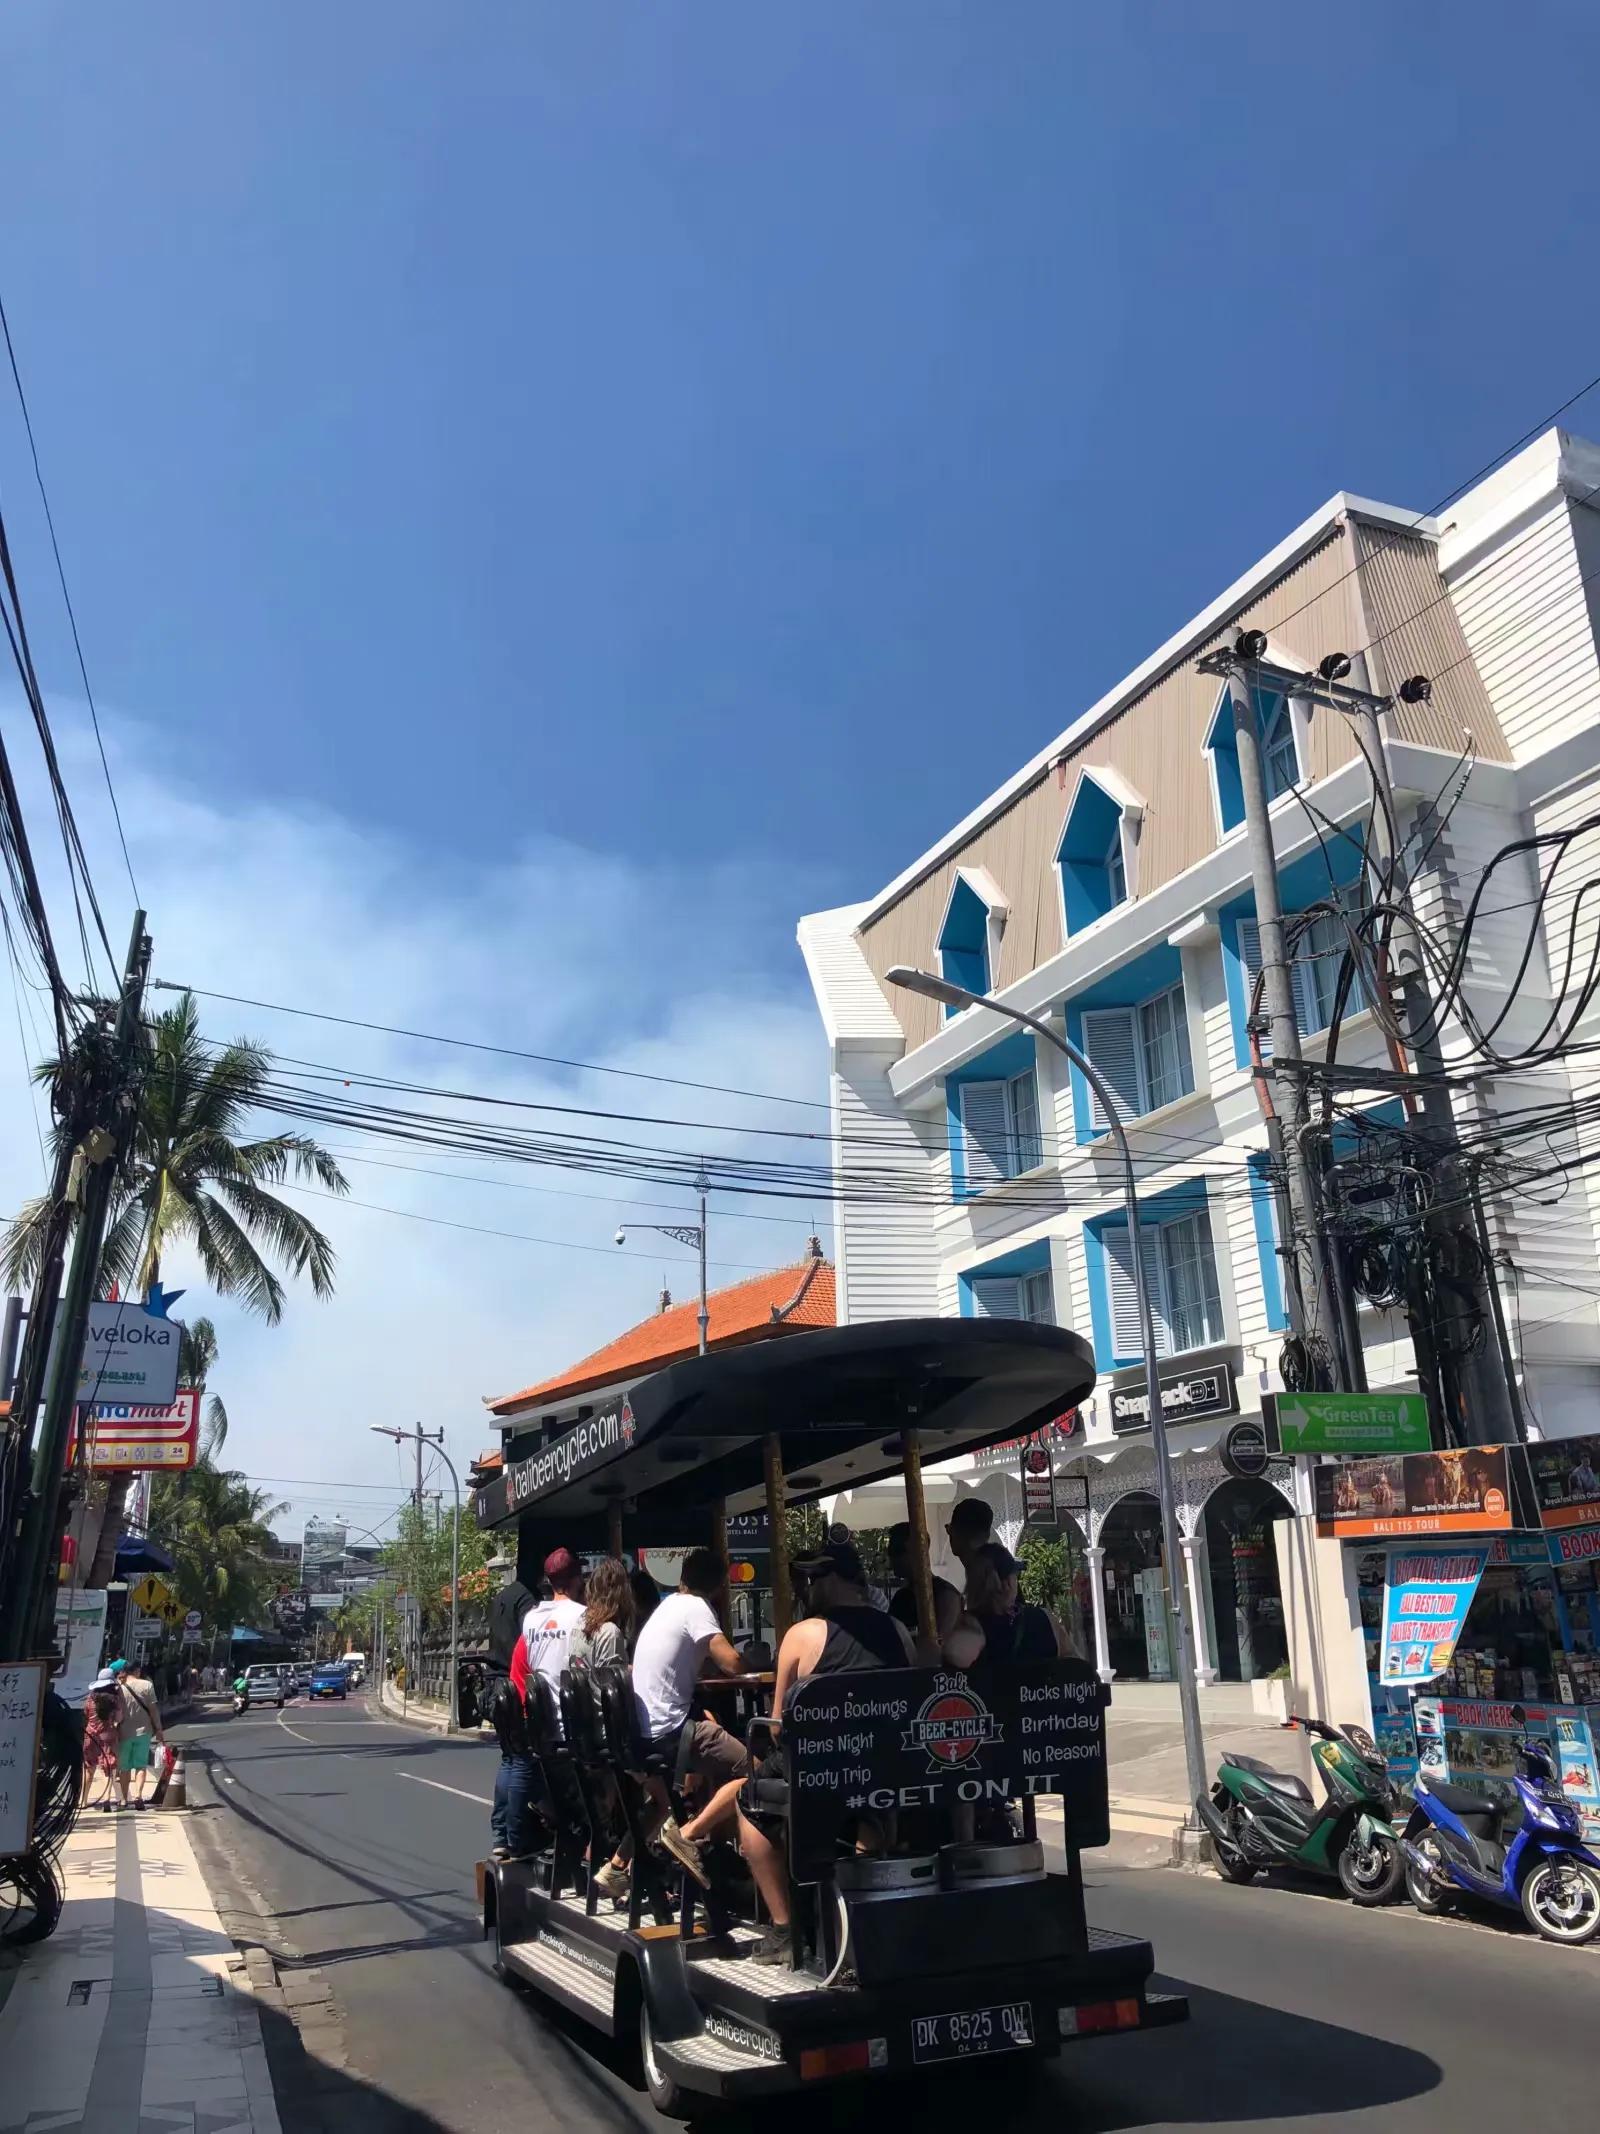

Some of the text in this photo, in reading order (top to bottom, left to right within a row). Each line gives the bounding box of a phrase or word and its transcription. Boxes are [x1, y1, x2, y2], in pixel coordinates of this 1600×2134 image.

[91, 1324, 170, 1345] veloka
[1115, 1382, 1191, 1421] Snapack
[514, 1413, 619, 1500] balibeercycle.com
[1373, 1521, 1393, 1533] BALI
[1416, 1518, 1440, 1530] TOUR
[933, 1672, 968, 1693] Bali
[1020, 1681, 1097, 1704] Bucks Night
[793, 1699, 908, 1723] Group Bookings
[1021, 1712, 1100, 1734] Birthday
[1456, 1703, 1484, 1726] BOOK
[919, 1719, 986, 1741] BEER-CYCLE
[798, 1732, 875, 1756] Hens Night
[1023, 1741, 1101, 1765] No Reason!
[798, 1765, 871, 1789] Footy Trip
[846, 1774, 1060, 1809] #GET ON IT
[705, 2014, 782, 2060] #balibeercycle
[917, 2019, 939, 2047] DK
[950, 2011, 992, 2041] 8525
